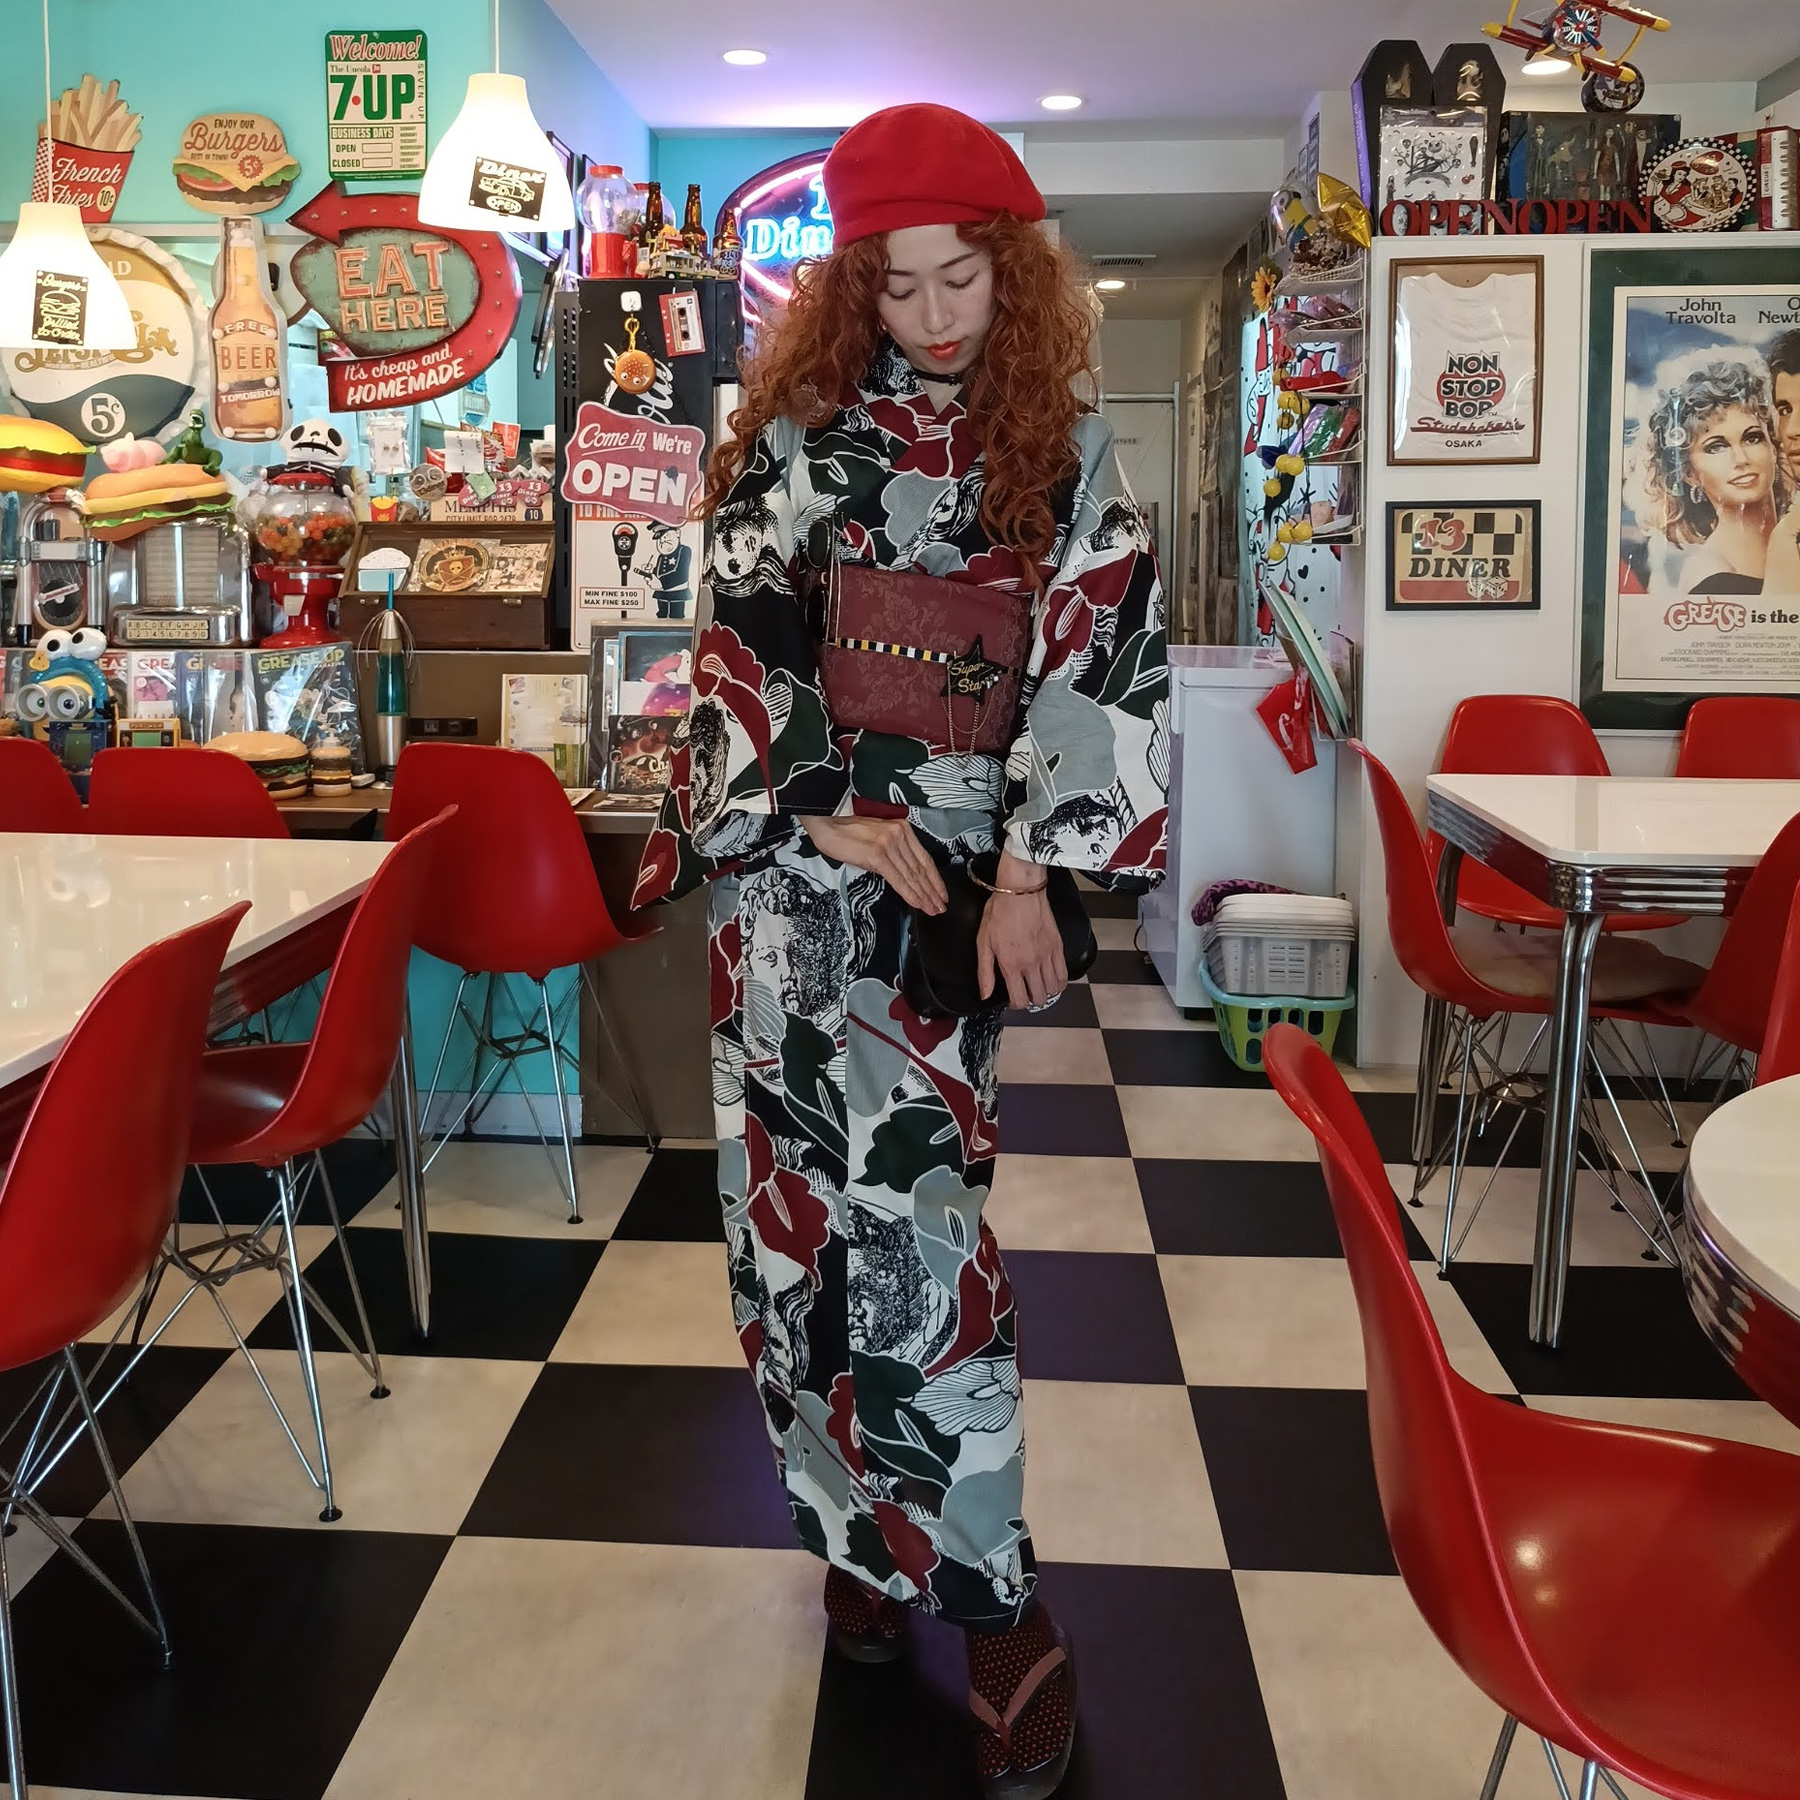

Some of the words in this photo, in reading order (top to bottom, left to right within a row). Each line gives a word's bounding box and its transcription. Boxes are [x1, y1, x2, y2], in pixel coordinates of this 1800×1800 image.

[329, 34, 423, 61] Welcome!
[330, 65, 344, 73] The
[214, 119, 238, 129] ENJOY
[240, 120, 255, 129] OUR
[332, 127, 371, 139] BUSINESS
[372, 127, 394, 138] DAYS
[184, 122, 283, 160] Burgers
[335, 144, 357, 153] OPEN
[52, 157, 123, 184] French
[332, 159, 361, 168] CLOSED
[53, 184, 96, 208] Fries
[1381, 200, 1518, 236] OPEN
[1518, 197, 1652, 235] OPEN
[334, 241, 449, 299] EAT
[340, 294, 448, 335] HERE
[1680, 298, 1721, 311] John
[224, 321, 270, 335] FREE
[1666, 311, 1736, 324] Travolta
[220, 346, 277, 370] BEER
[344, 363, 368, 381] It's
[371, 358, 419, 378] cheap
[421, 342, 453, 366] and
[1446, 350, 1500, 376] NON
[346, 358, 466, 406] HOMEMADE
[1442, 379, 1501, 397] STOP
[220, 388, 280, 403] TOMORROW
[1444, 400, 1493, 418] BOP
[577, 423, 629, 449] Come
[631, 429, 647, 452] in
[653, 432, 692, 455] We're
[499, 482, 512, 492] 13
[528, 482, 542, 491] 13
[572, 460, 687, 506] OPEN
[529, 509, 538, 520] 10
[1420, 519, 1466, 552] 13
[1408, 557, 1511, 578] DINER
[1664, 599, 1747, 632] GREASE
[1751, 610, 1767, 623] is
[1770, 610, 1799, 623] the
[257, 651, 320, 672] GREASE
[950, 661, 982, 678] Super
